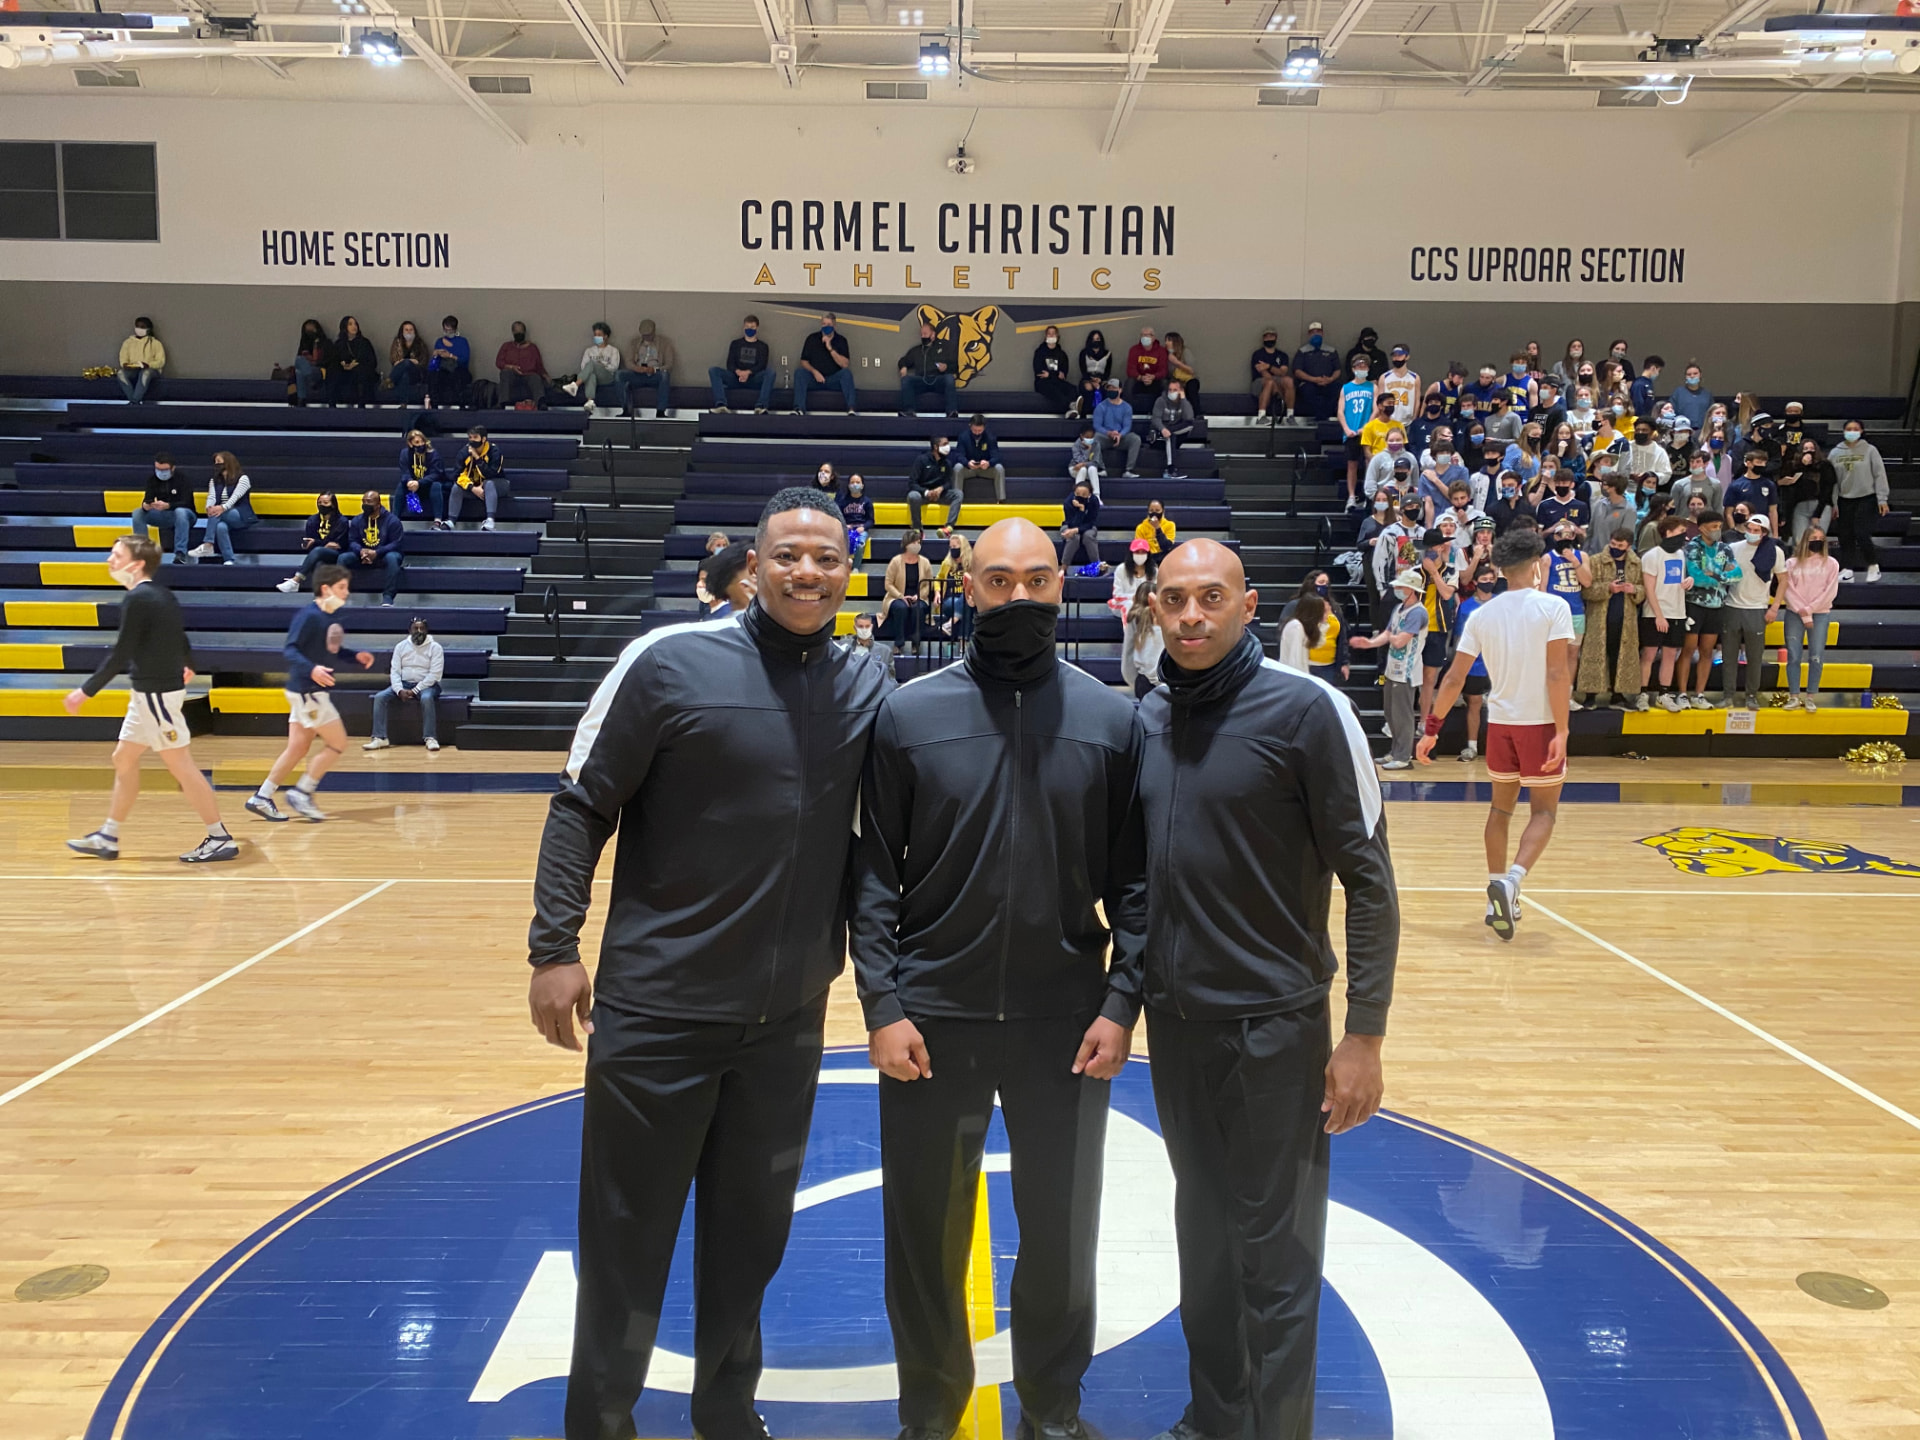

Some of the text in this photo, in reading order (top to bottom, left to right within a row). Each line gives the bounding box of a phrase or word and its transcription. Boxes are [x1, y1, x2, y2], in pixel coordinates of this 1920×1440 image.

[742, 199, 1175, 256] CARMEL CHRISTIAN
[262, 229, 450, 268] HOME SECTION
[754, 262, 1162, 291] ATHLETICS
[1410, 246, 1685, 284] CCS UPROAR SECTION
[1345, 389, 1373, 401] CHARLOTTE
[1352, 398, 1365, 414] 33
[1558, 569, 1579, 586] 15
